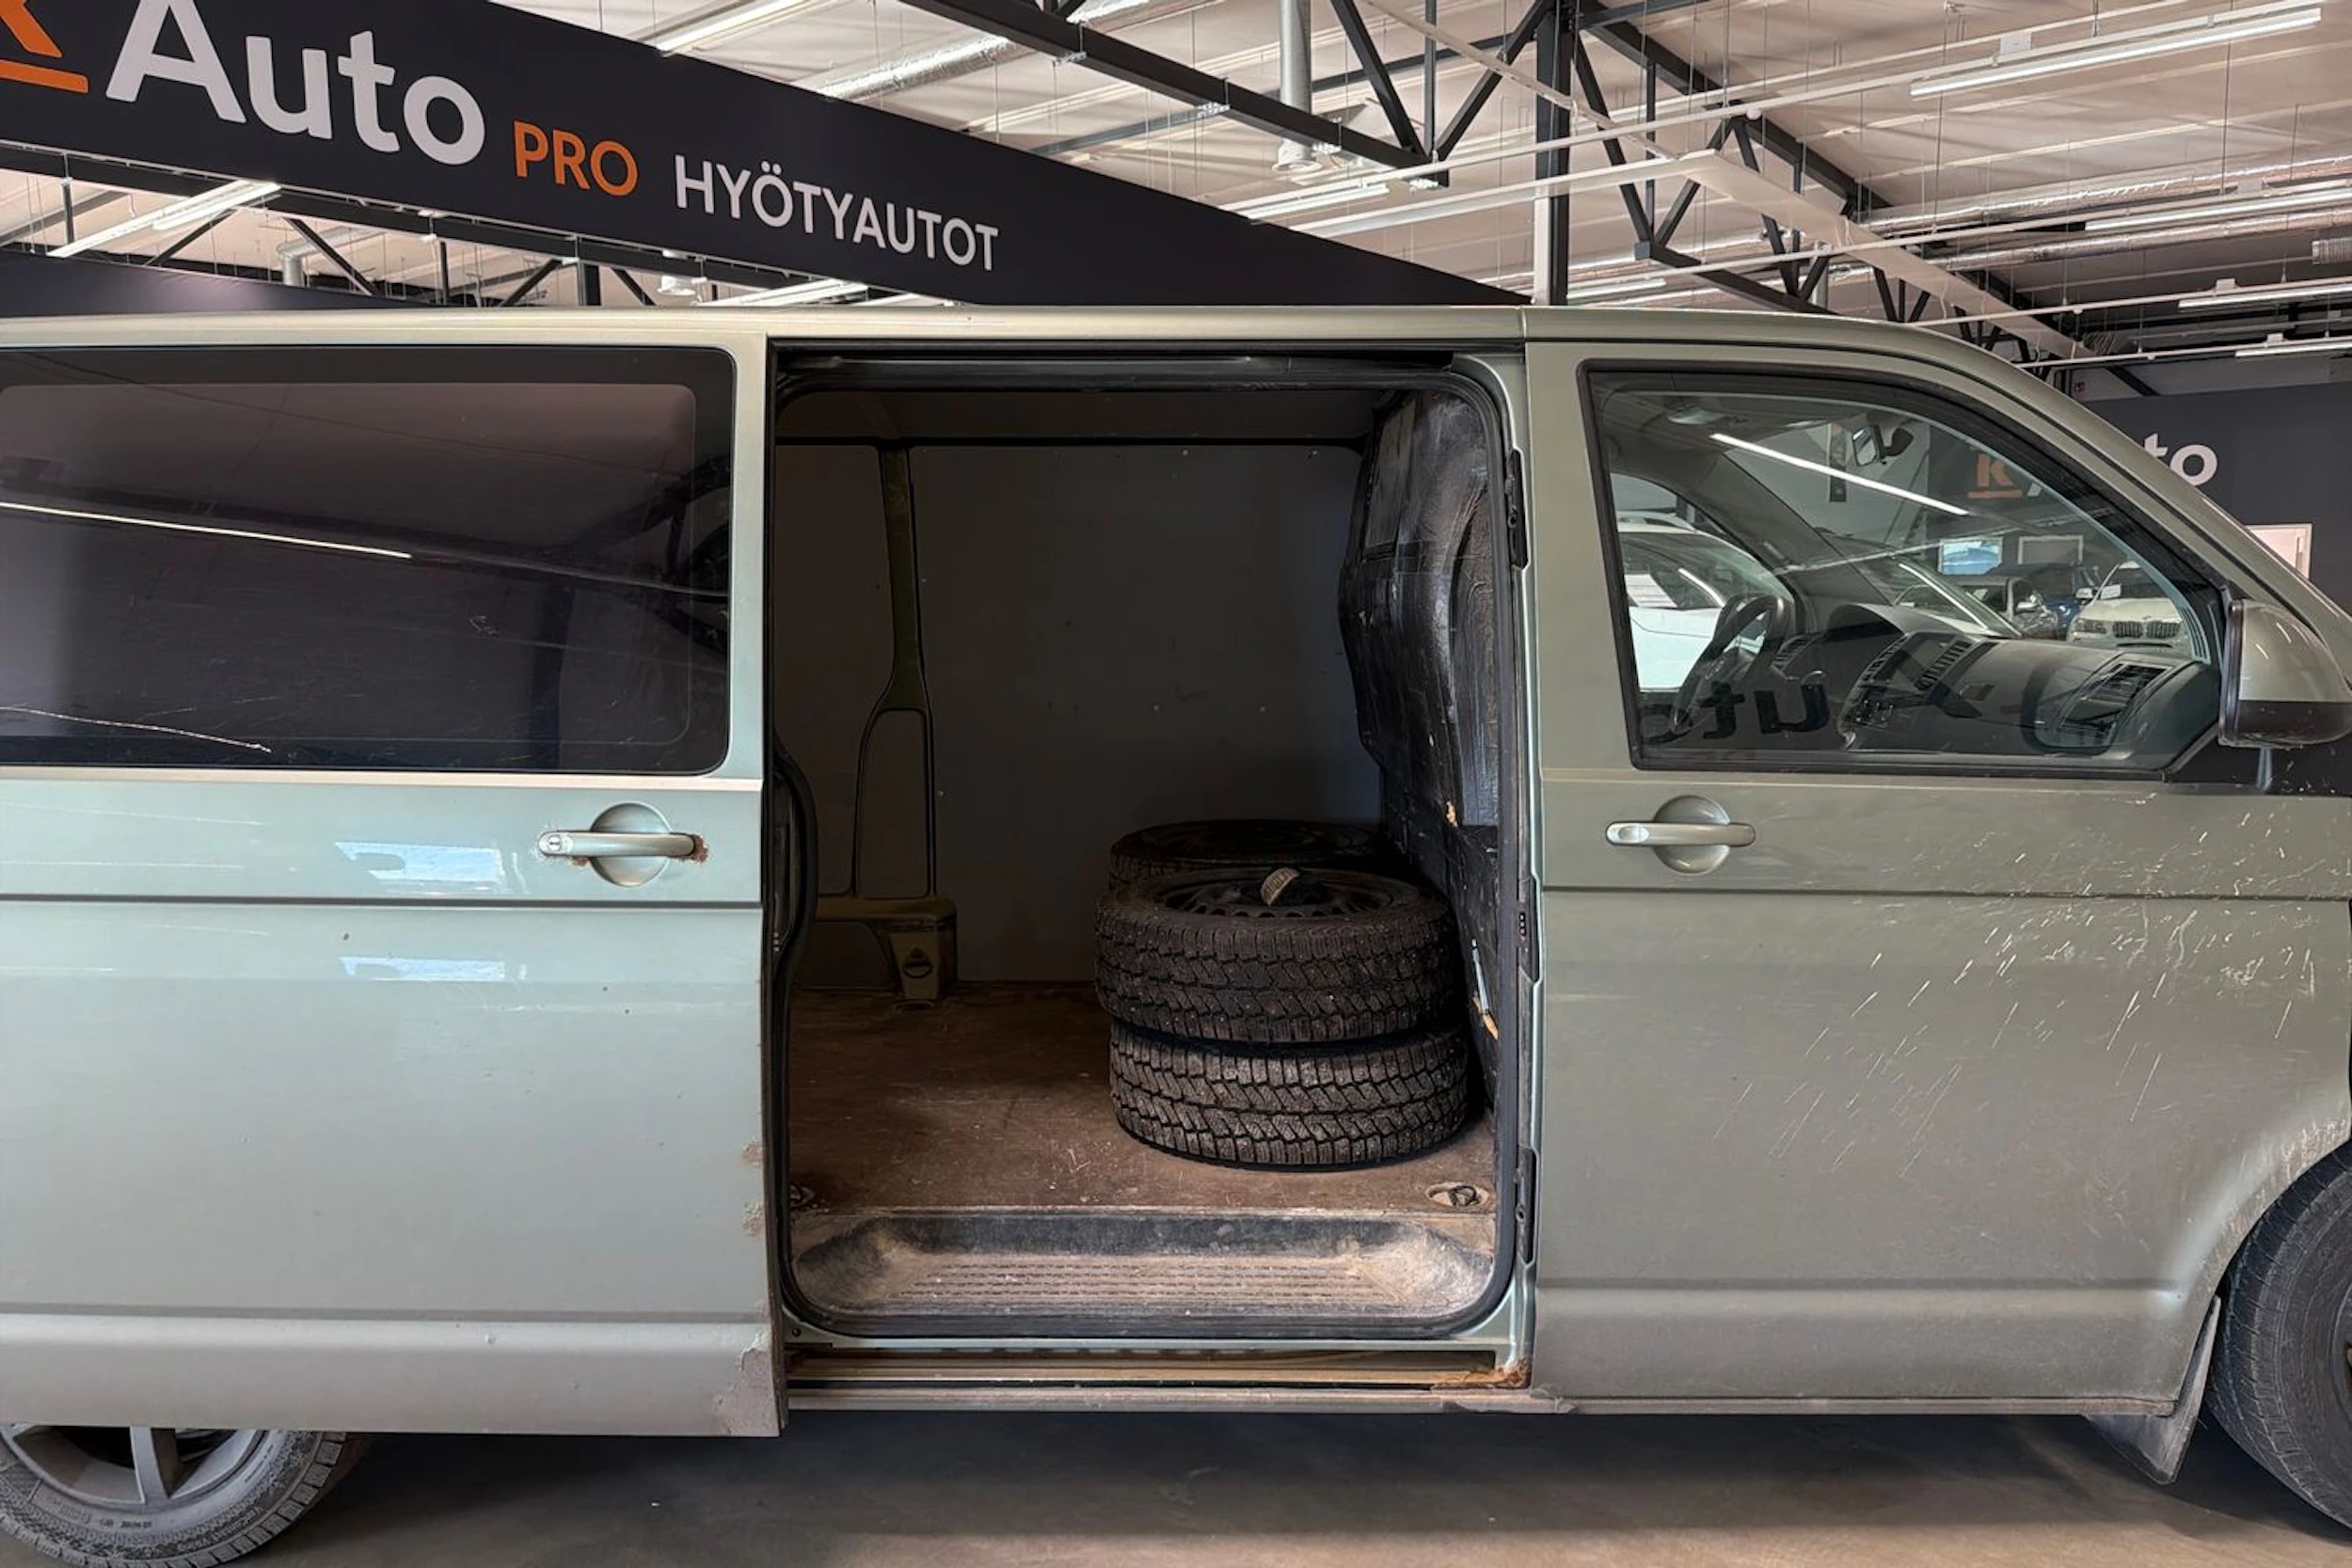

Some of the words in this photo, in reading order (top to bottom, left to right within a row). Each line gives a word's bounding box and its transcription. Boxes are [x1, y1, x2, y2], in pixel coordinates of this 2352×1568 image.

[105, 0, 485, 166] Auto
[514, 119, 639, 197] PRO
[674, 154, 999, 271] HYÖTYAUTOT
